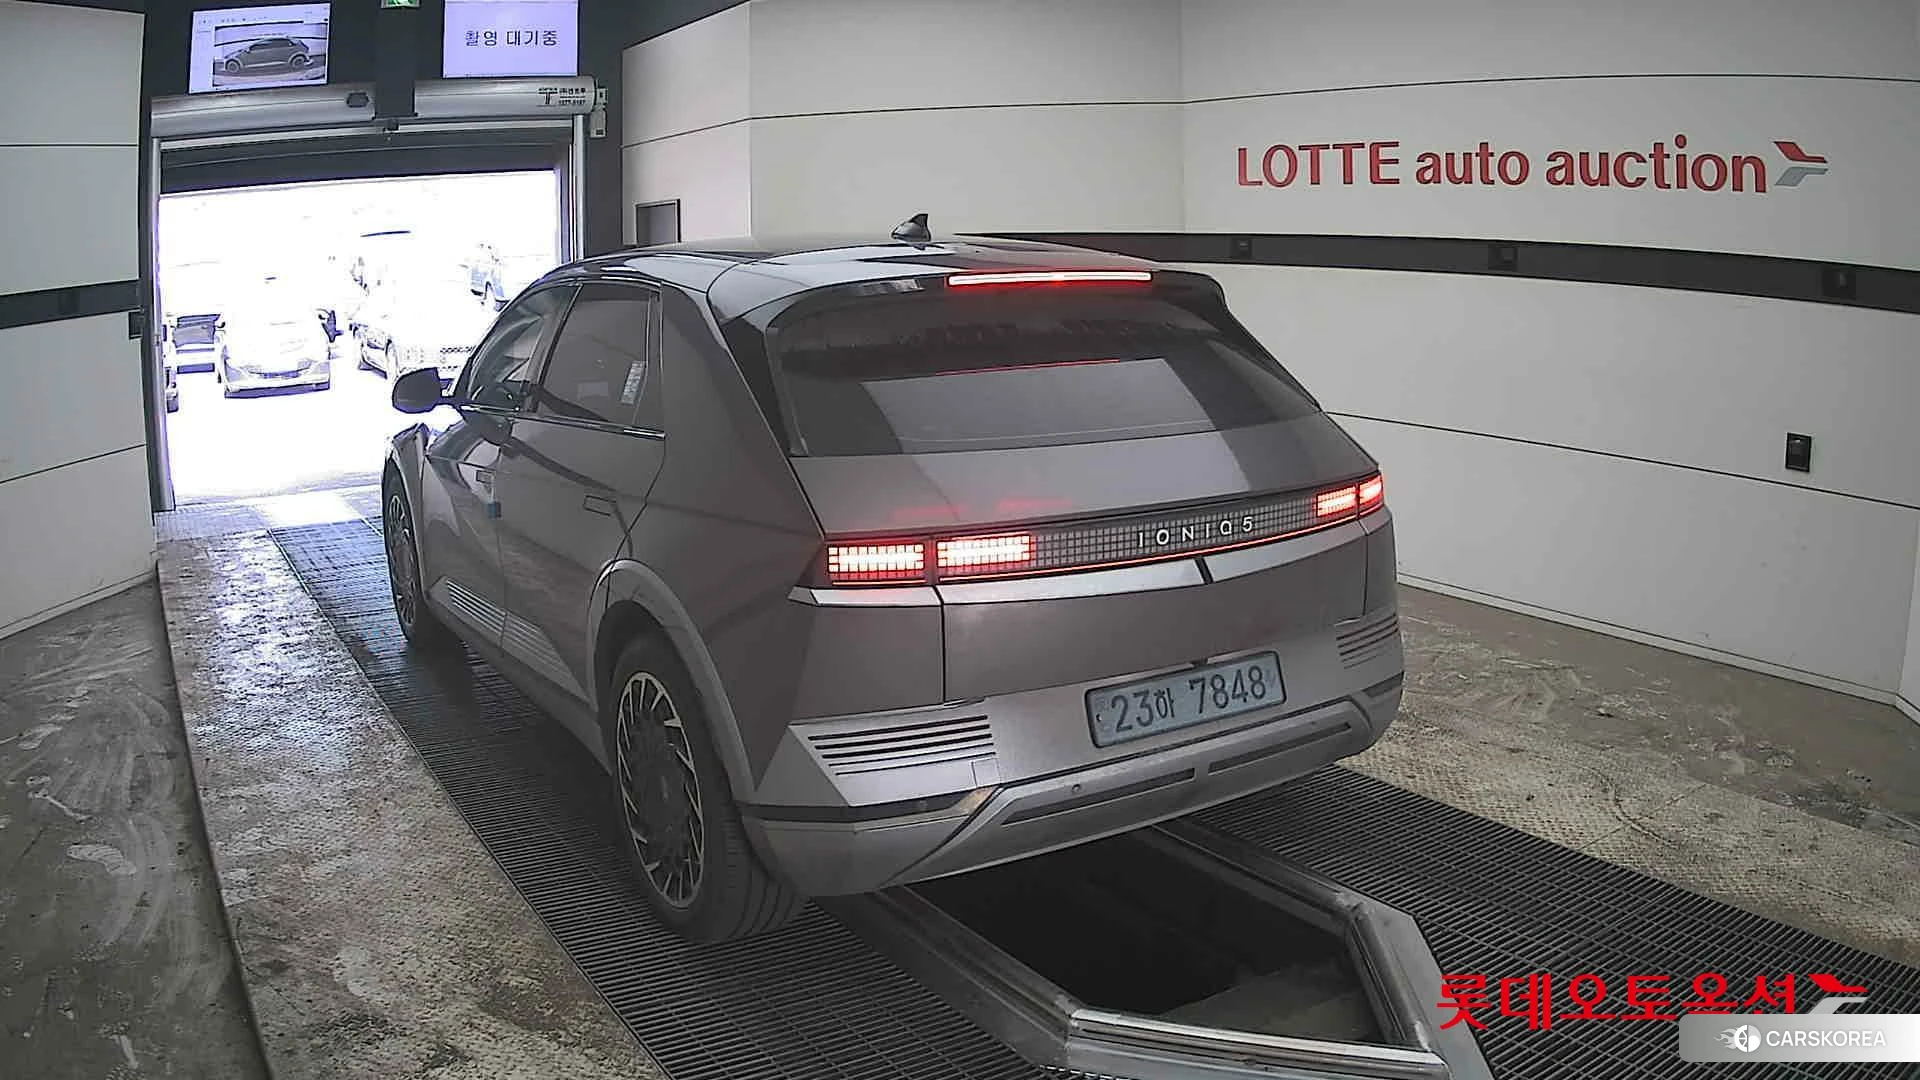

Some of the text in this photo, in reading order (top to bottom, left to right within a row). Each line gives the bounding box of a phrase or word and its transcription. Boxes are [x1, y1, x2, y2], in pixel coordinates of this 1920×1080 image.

[465, 29, 558, 47] 촬영 대기중
[1237, 133, 1768, 194] LOTTE auto auction
[1111, 664, 1267, 733] 23하 7848
